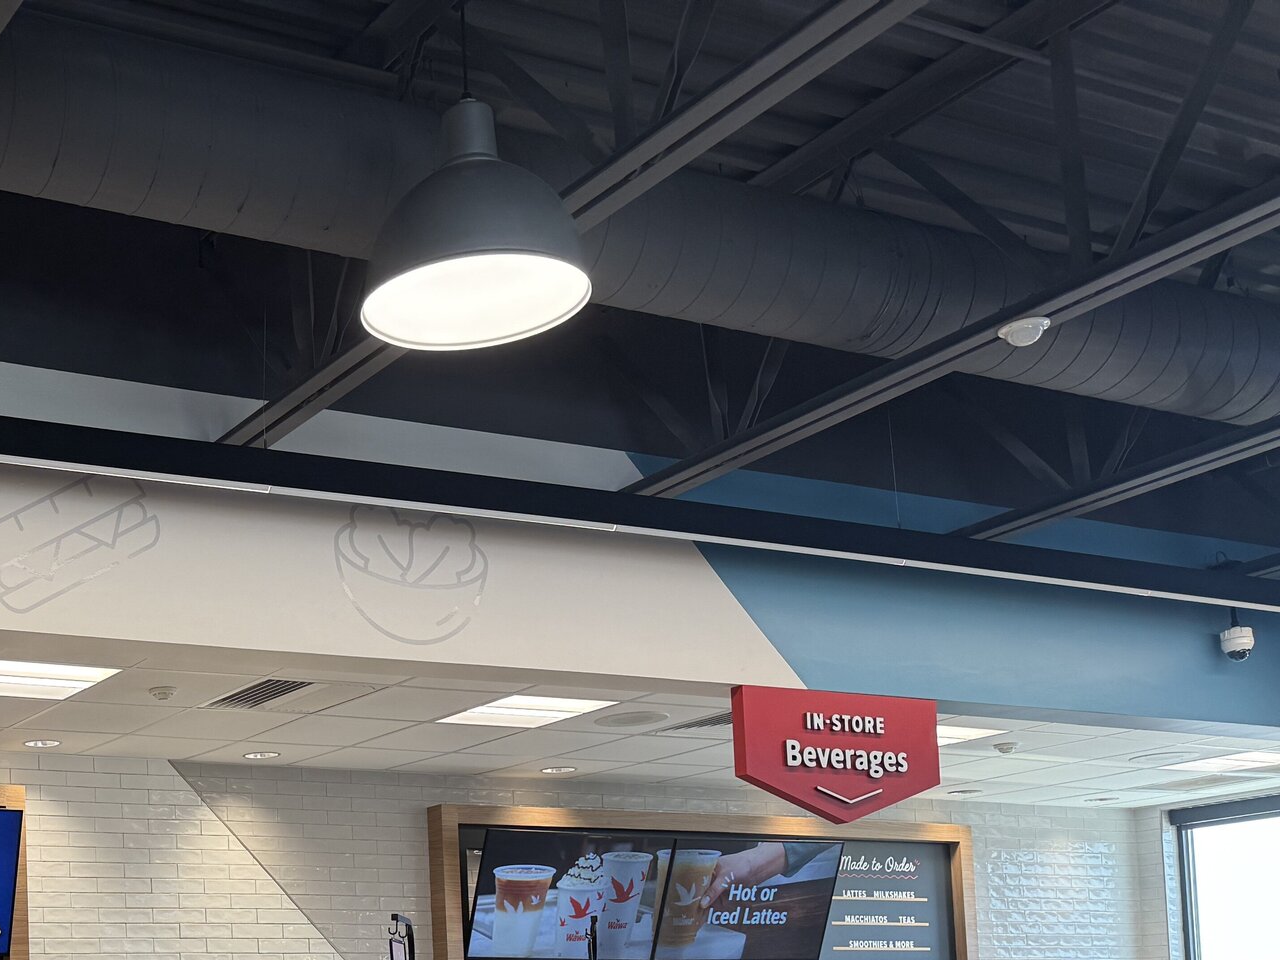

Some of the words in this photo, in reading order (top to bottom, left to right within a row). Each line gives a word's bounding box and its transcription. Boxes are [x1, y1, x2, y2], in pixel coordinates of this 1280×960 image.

[806, 712, 884, 734] IN-STORE
[785, 739, 908, 778] Beverages
[839, 855, 869, 871] Made
[871, 857, 882, 871] to
[884, 856, 916, 872] Order
[728, 884, 757, 901] Hot
[760, 888, 777, 901] or
[843, 890, 867, 898] LATTES
[873, 890, 915, 898] MILKSHAKES
[707, 906, 741, 924] Iced
[742, 907, 787, 925] Lattes
[845, 915, 887, 923] MACCHIATOS
[849, 940, 887, 948] SMOOTHIES
